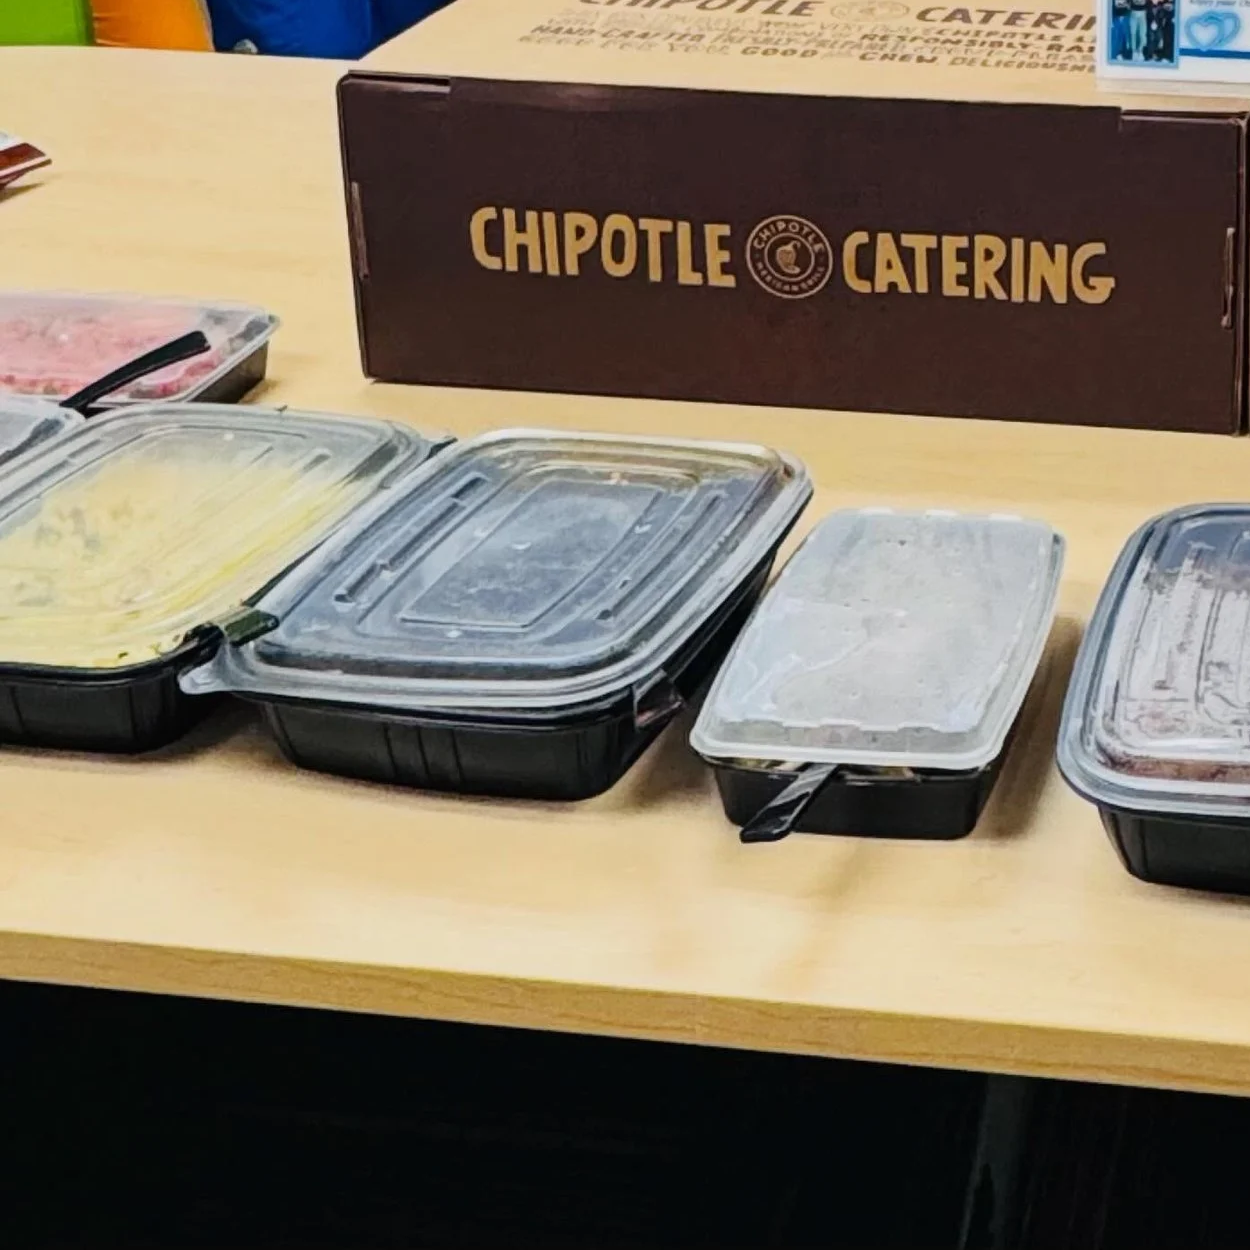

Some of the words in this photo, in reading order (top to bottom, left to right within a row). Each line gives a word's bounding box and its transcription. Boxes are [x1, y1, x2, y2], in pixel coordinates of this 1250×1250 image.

[916, 6, 1096, 31] CATERI
[740, 45, 819, 59] GOOD
[468, 206, 736, 288] CHIPOTLE
[753, 220, 825, 253] CHIPOTLE
[843, 230, 1116, 305] CATERING
